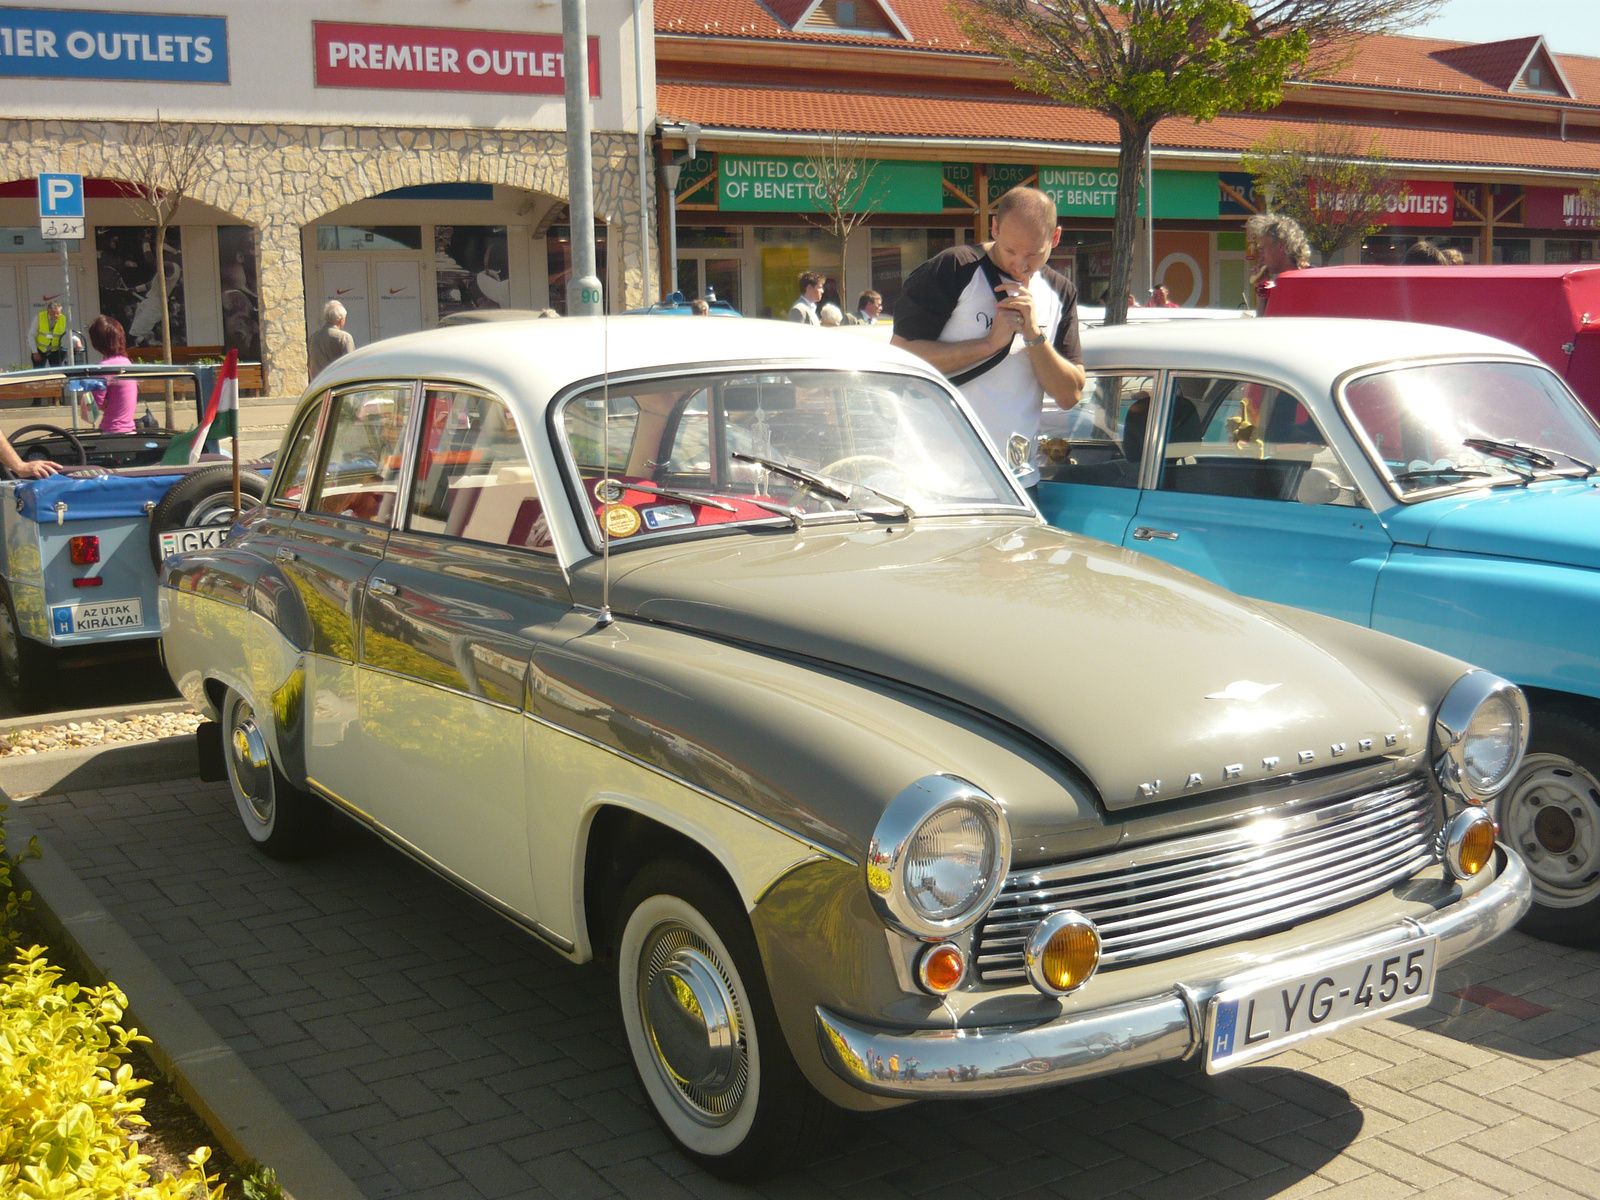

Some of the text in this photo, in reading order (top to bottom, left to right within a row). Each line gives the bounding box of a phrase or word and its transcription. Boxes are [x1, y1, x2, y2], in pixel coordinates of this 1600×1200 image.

[0, 28, 214, 64] 1ER OUTLETS
[467, 49, 565, 78] OUTLET
[724, 160, 789, 178] UNITED
[1043, 170, 1096, 187] UNITED
[48, 179, 74, 210] P
[725, 181, 749, 198] OF
[1385, 194, 1448, 214] OUTLETS
[62, 223, 69, 233] 2
[581, 289, 600, 304] 90
[83, 604, 131, 618] AZ UTAK
[60, 622, 69, 632] H
[77, 614, 139, 630] KIRÁLYA!
[1137, 734, 1398, 797] WARTBURG
[1244, 948, 1425, 1046] LYG-455
[1215, 1033, 1229, 1053] H
